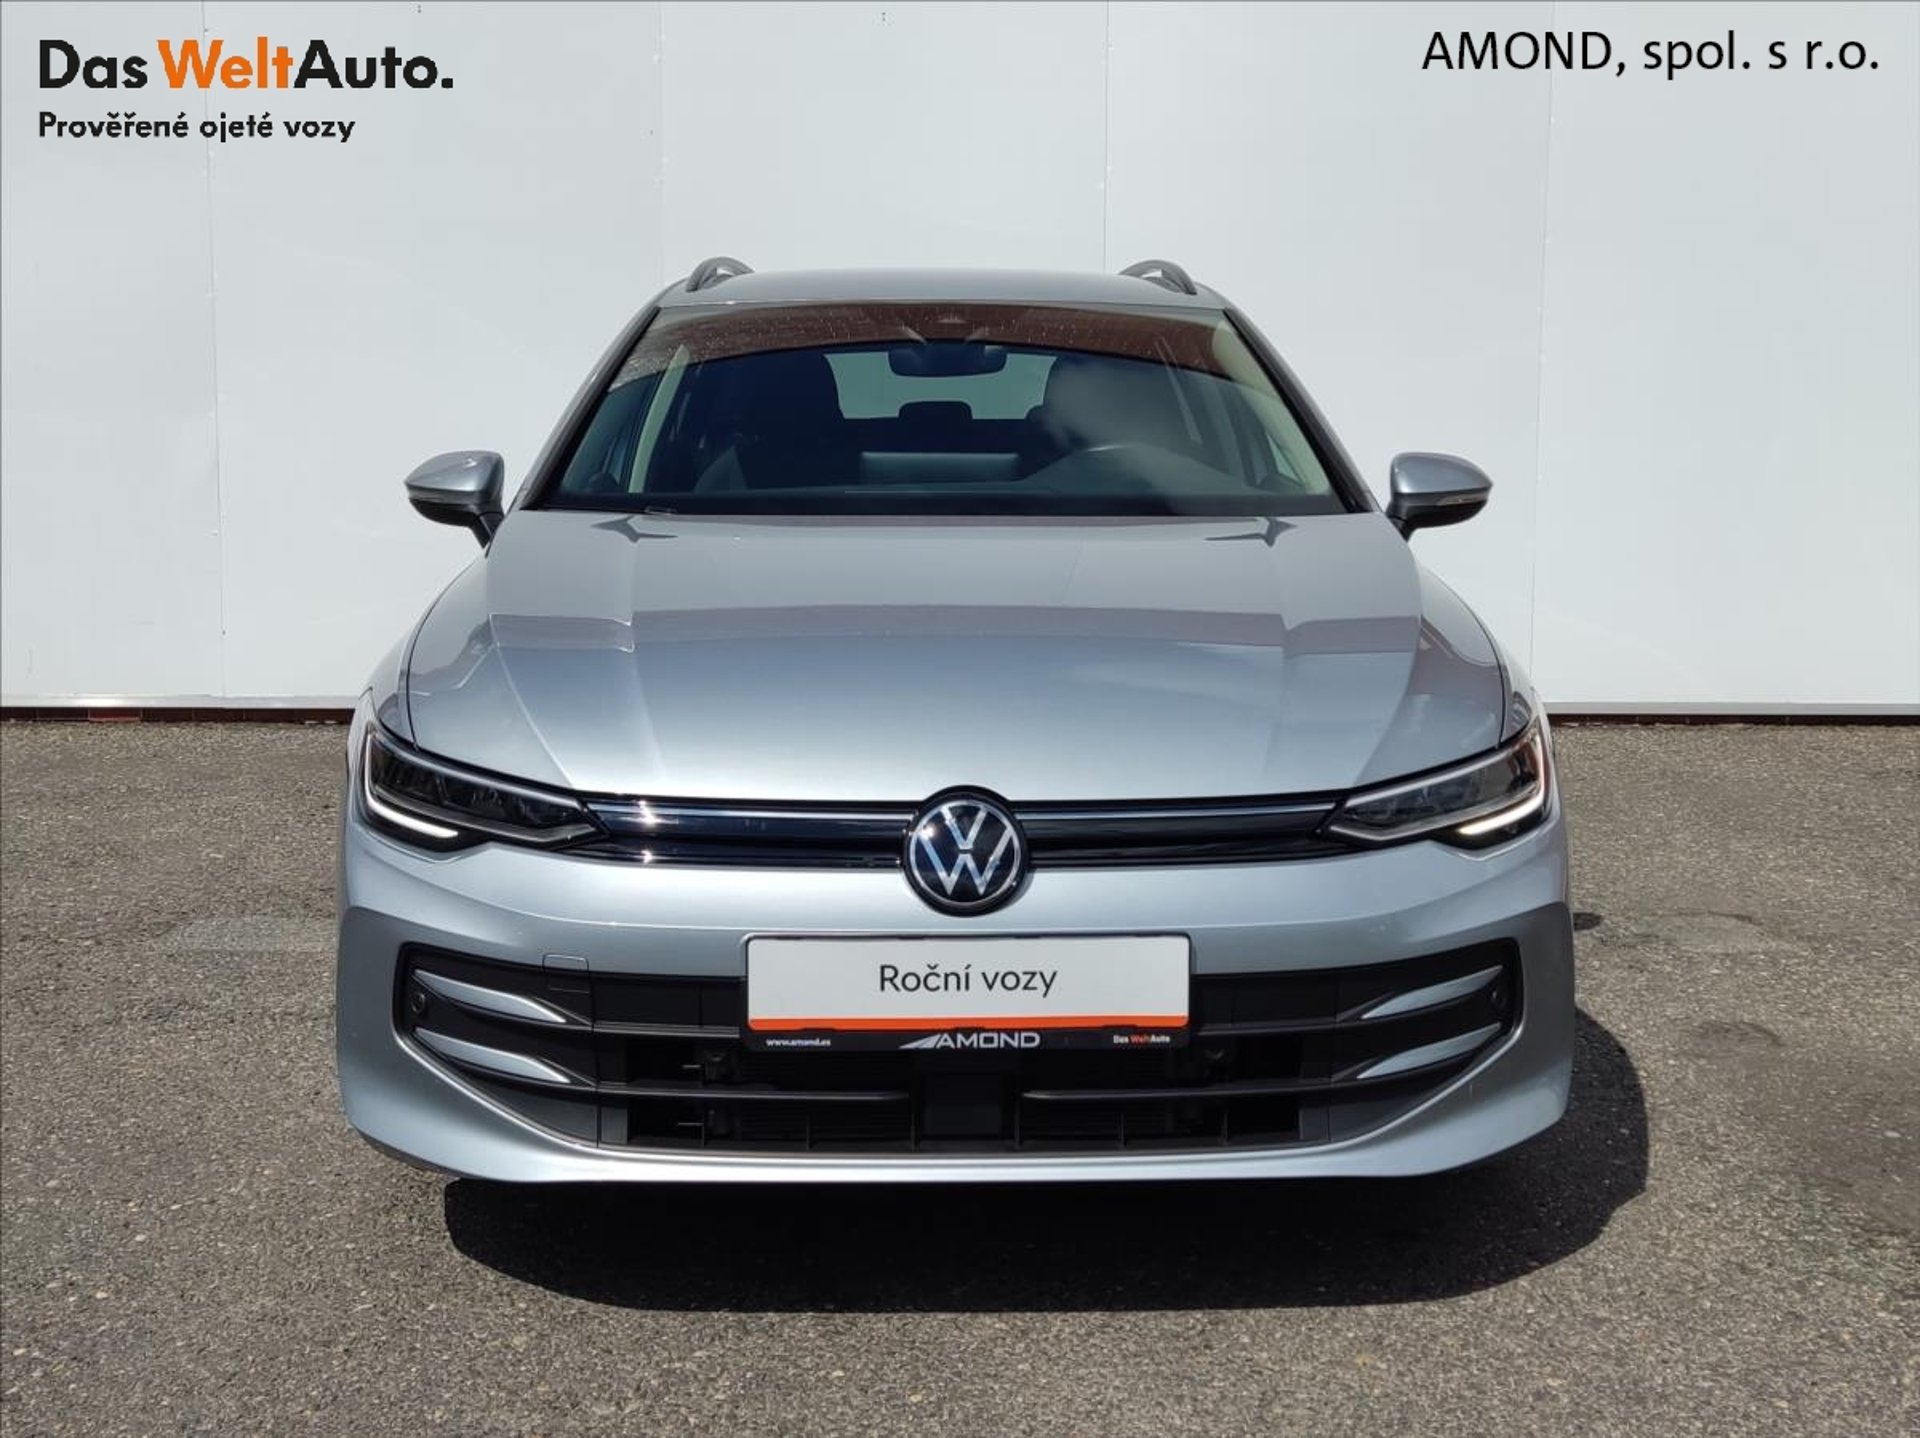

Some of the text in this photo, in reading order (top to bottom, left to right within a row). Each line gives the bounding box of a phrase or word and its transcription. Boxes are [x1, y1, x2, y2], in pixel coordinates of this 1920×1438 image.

[879, 963, 1058, 999] Roční vozy
[935, 1032, 1041, 1049] AMOND
